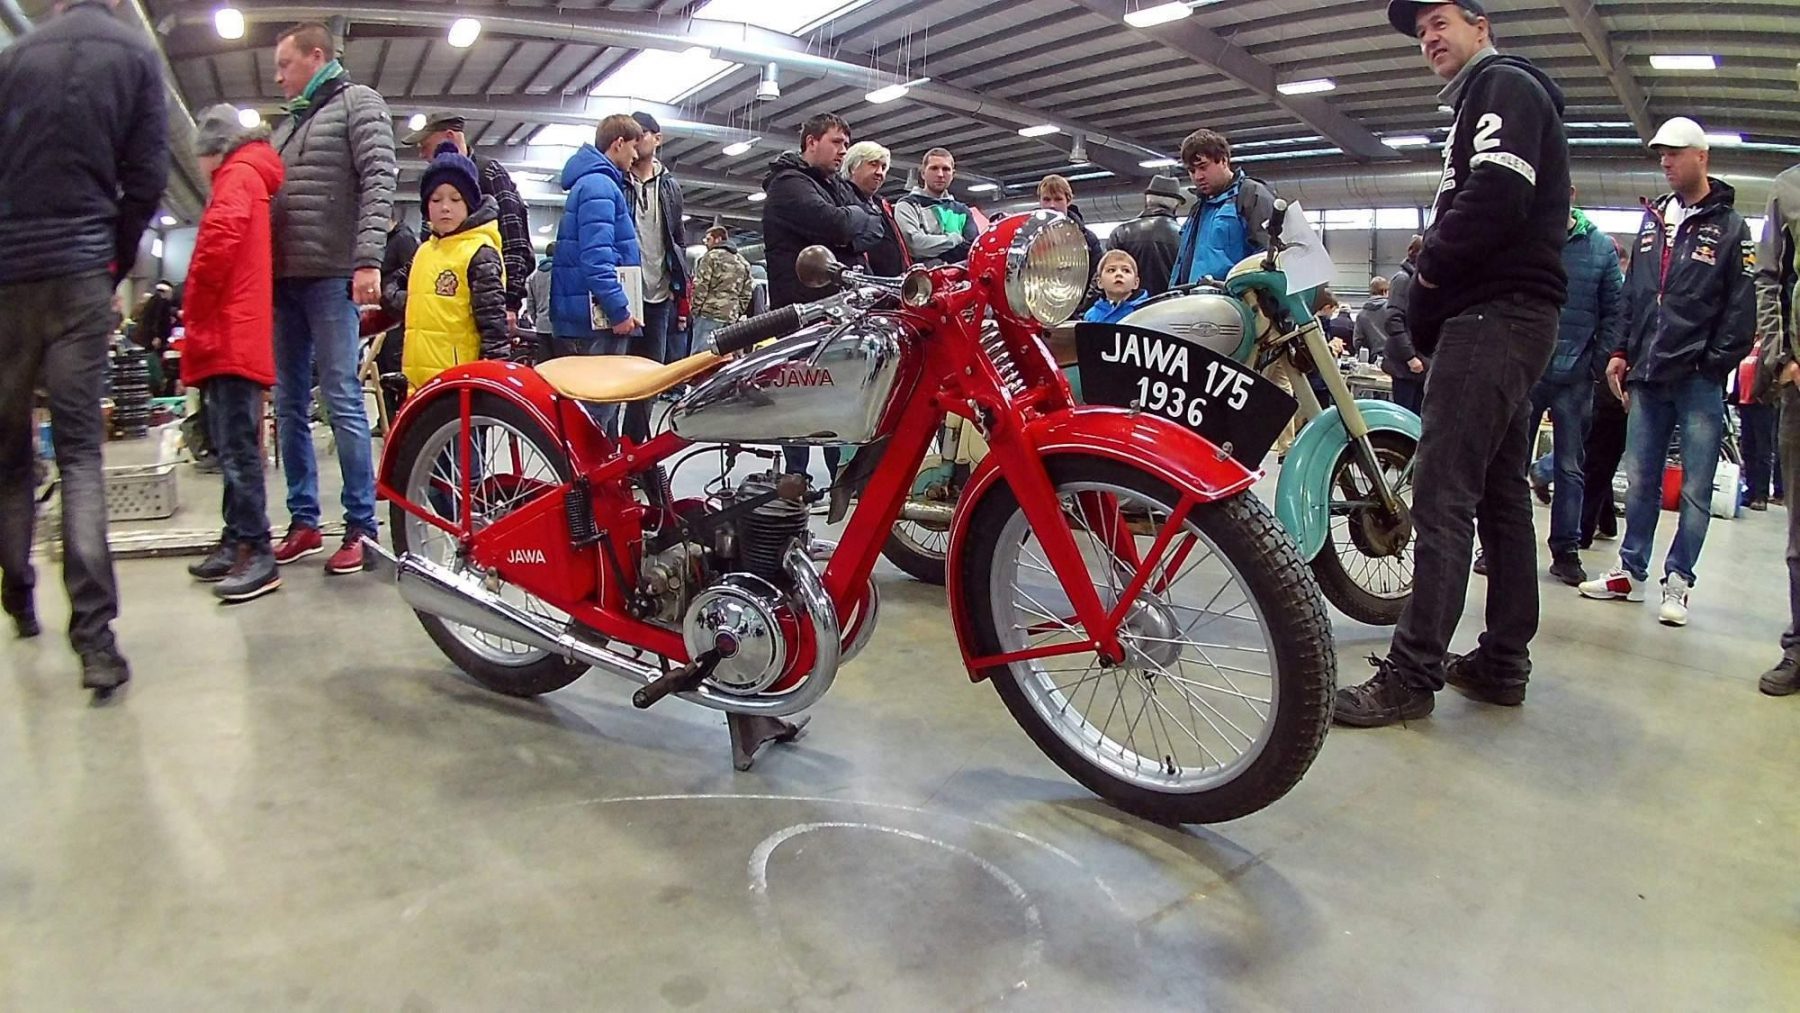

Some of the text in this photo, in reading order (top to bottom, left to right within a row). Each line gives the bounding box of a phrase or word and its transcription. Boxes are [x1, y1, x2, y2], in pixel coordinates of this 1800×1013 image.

[1473, 113, 1503, 152] 2
[774, 368, 834, 387] JAWA
[1101, 332, 1254, 411] JAWA 175
[1137, 376, 1207, 427] 1936
[506, 549, 546, 564] JAWA
